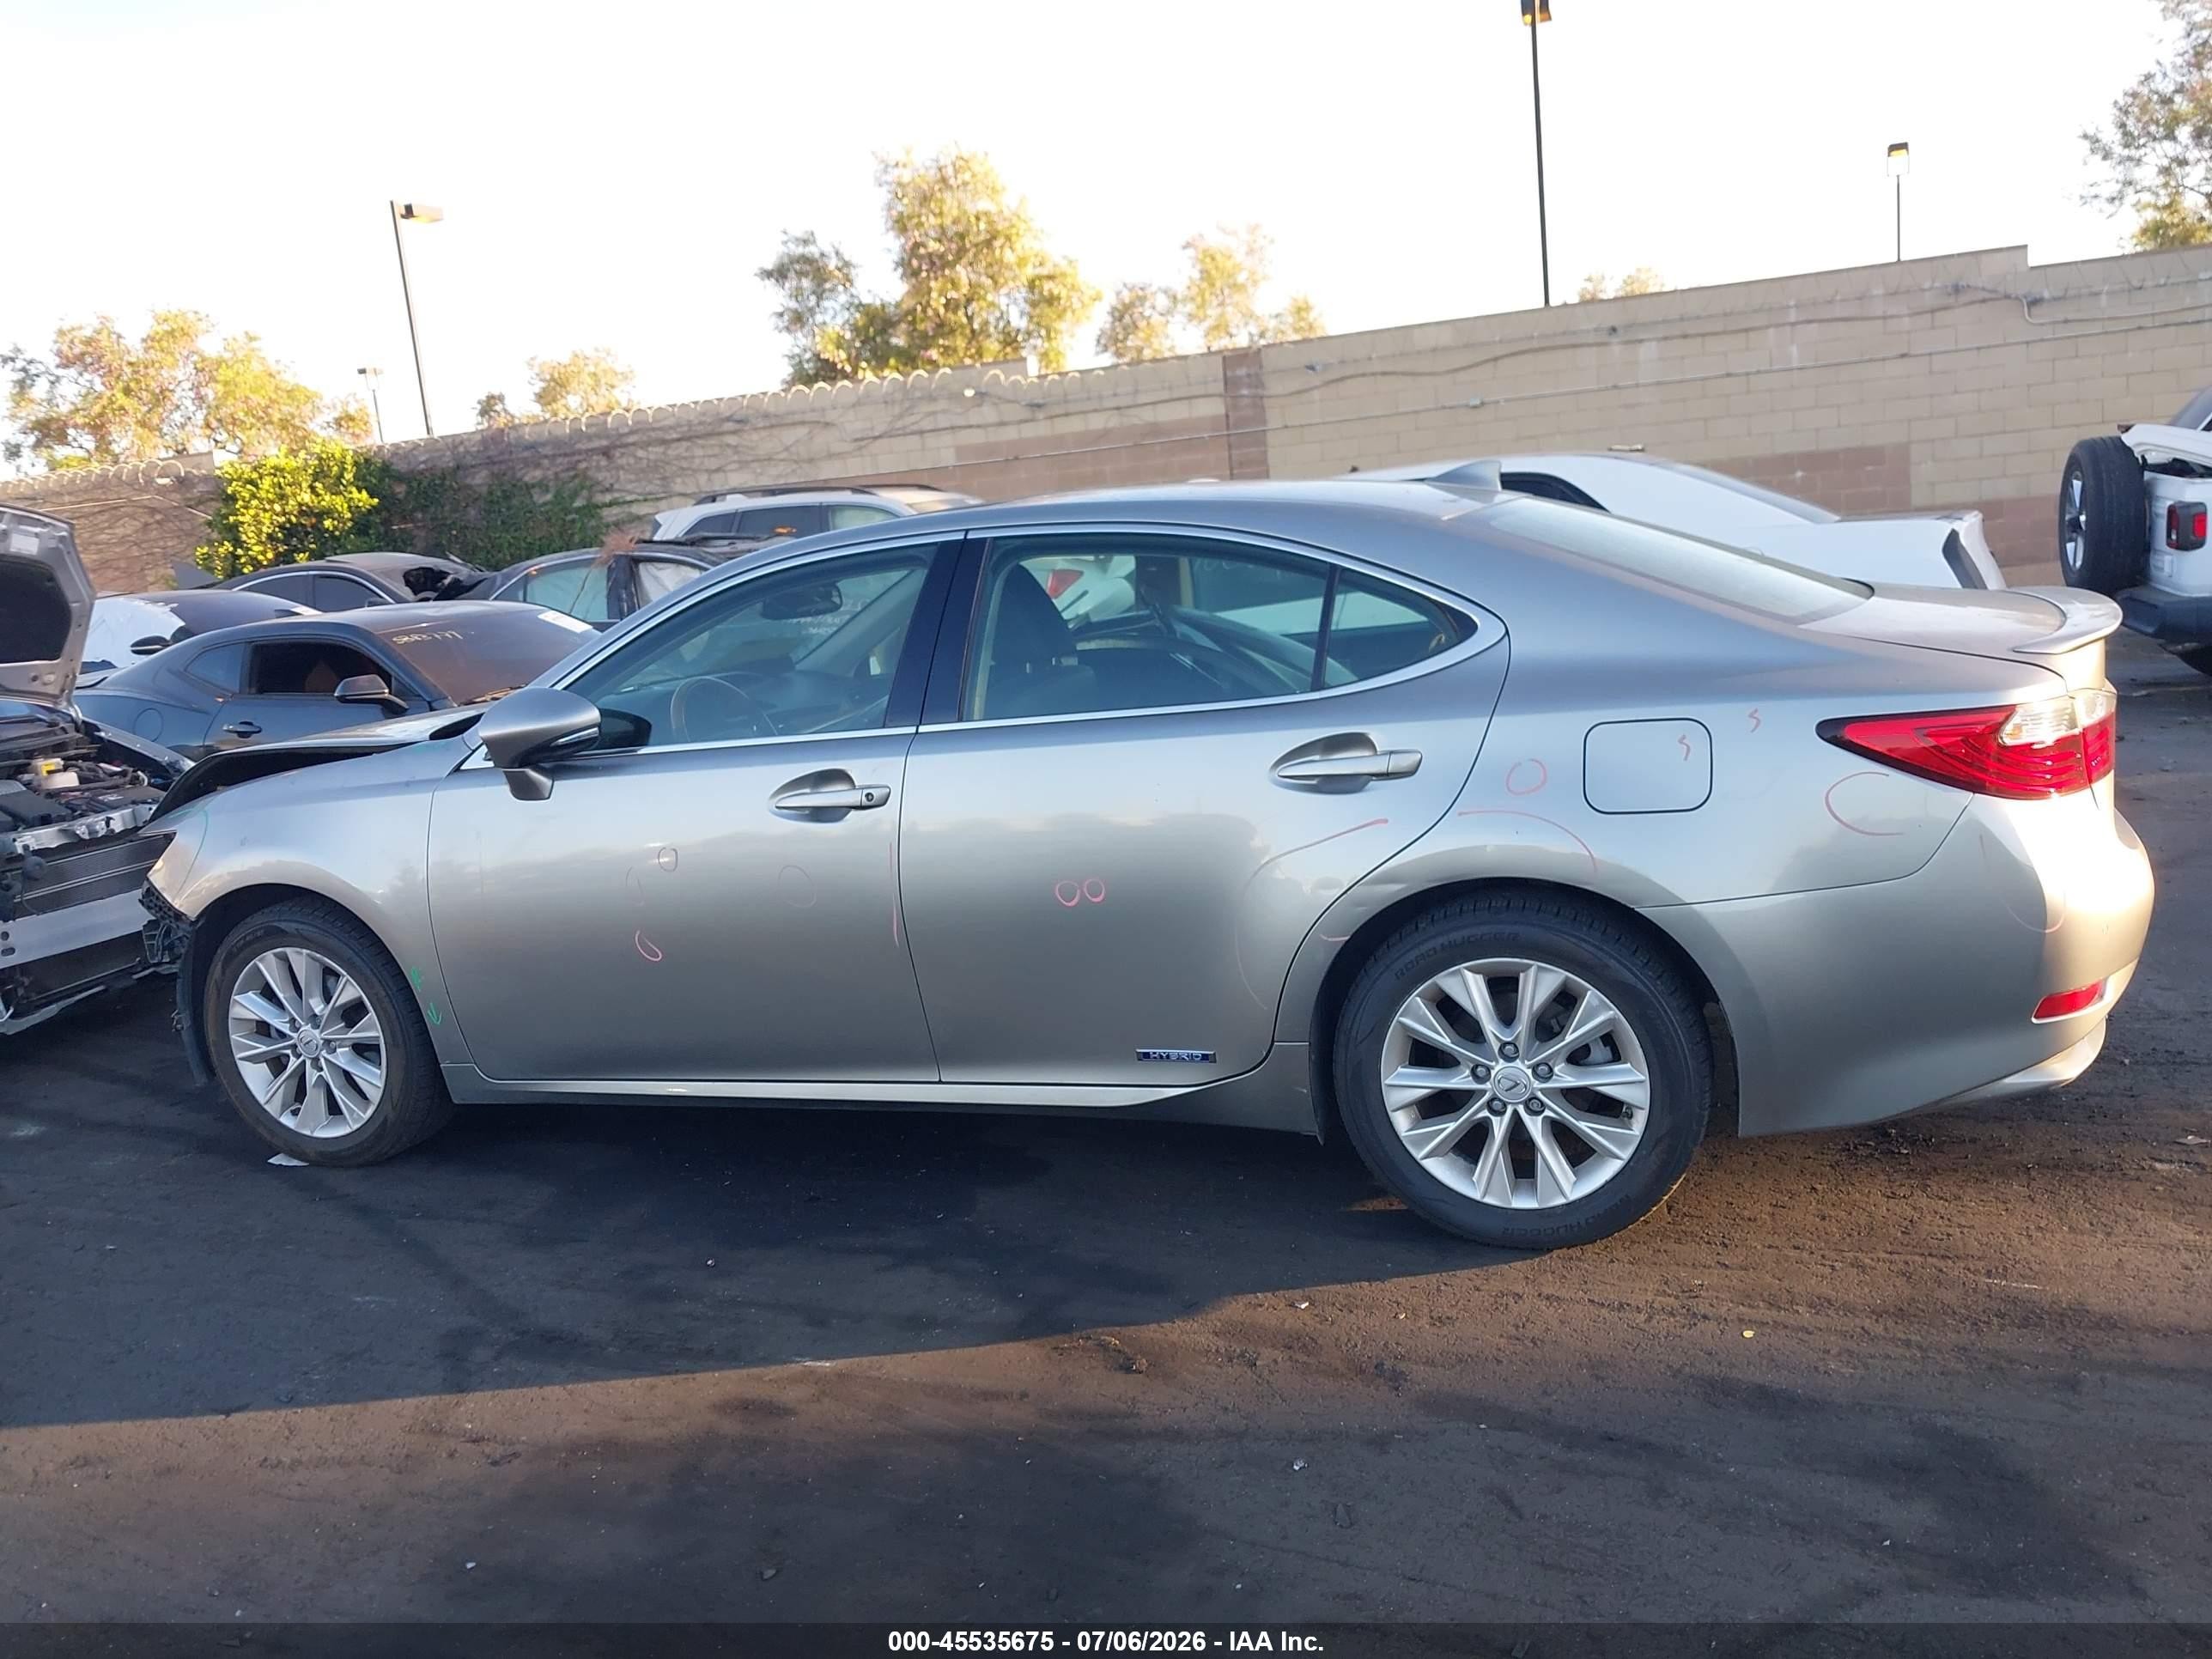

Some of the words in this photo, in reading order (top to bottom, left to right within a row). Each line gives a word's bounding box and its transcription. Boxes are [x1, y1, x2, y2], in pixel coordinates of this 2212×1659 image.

[1394, 946, 1438, 981] ROAD
[1439, 931, 1521, 952] HUGGER
[1149, 1051, 1202, 1061] HYBRID
